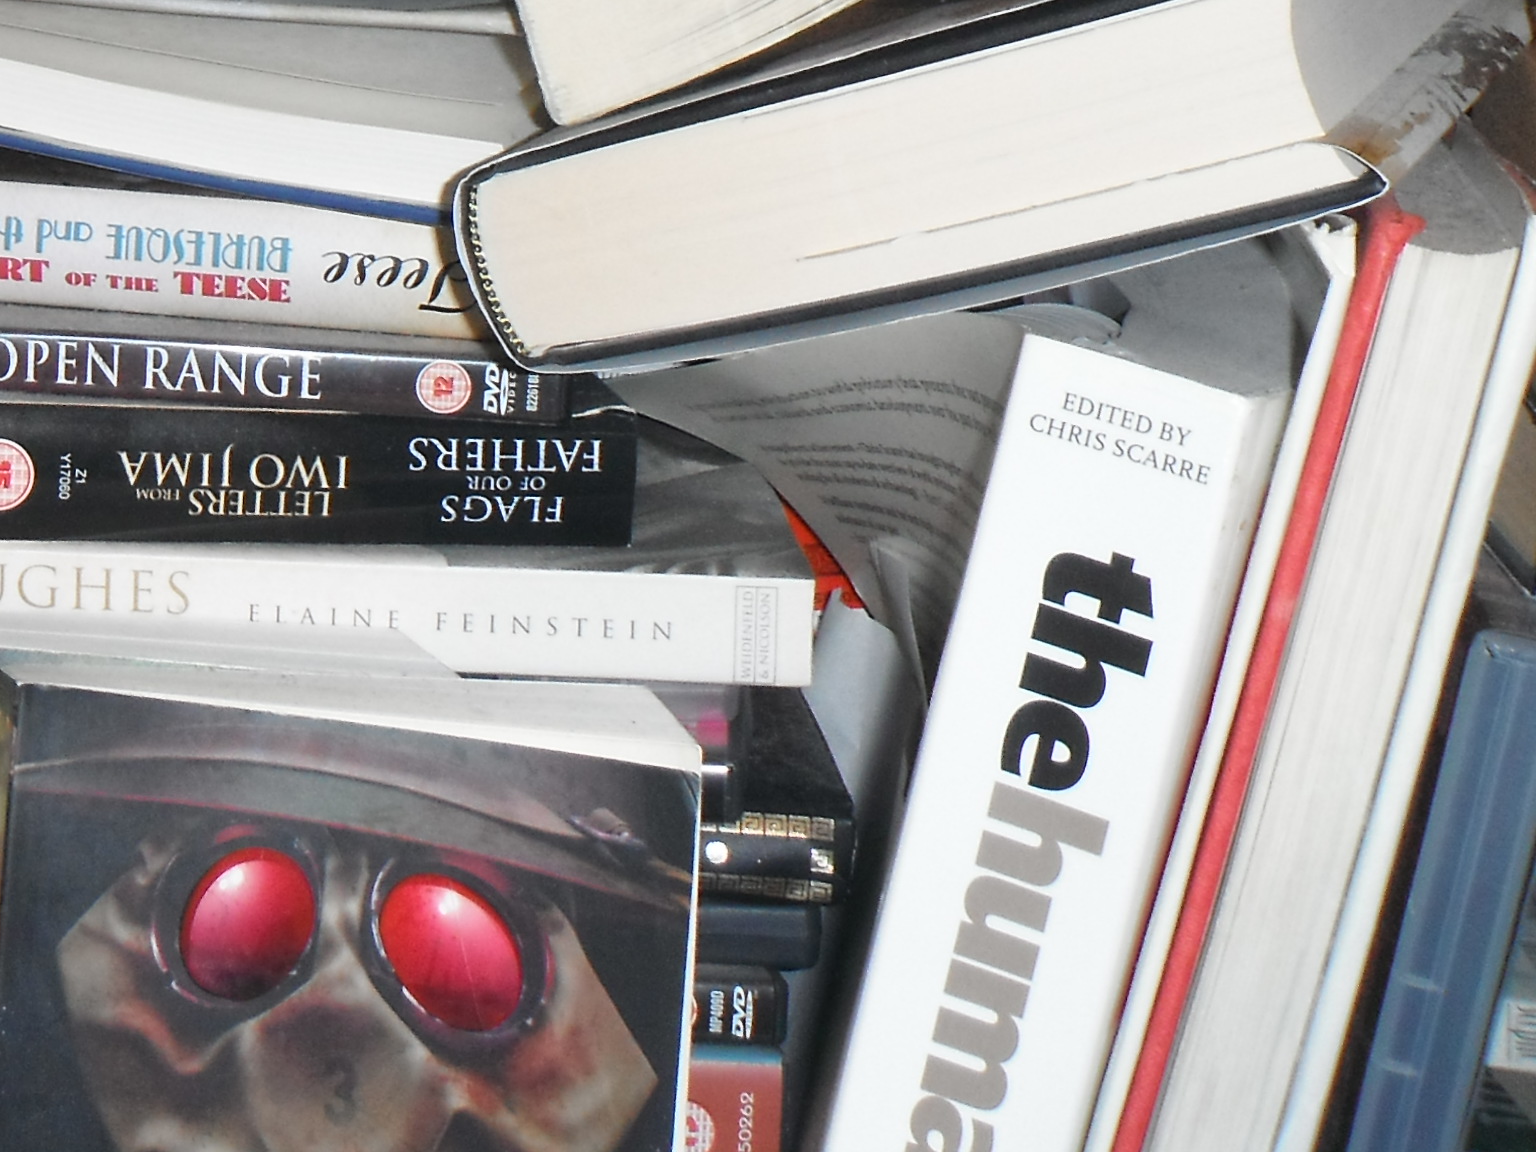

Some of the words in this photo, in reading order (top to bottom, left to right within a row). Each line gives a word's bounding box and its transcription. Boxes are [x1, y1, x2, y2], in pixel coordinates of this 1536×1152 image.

[36, 218, 93, 255] and
[107, 223, 293, 273] BURLESQUE
[65, 273, 98, 289] OF
[106, 275, 159, 294] THE
[174, 271, 292, 304] TEESE
[144, 347, 323, 400] RANGE
[433, 375, 455, 397] 12
[483, 362, 500, 414] DVD
[1062, 391, 1153, 437] EDITED
[1160, 421, 1191, 446] BY
[118, 445, 237, 489] JIMA
[409, 438, 602, 472] FATHERS
[1028, 415, 1108, 454] CHRIS
[1111, 437, 1211, 486] SCARRE
[58, 452, 72, 501] Y17060
[250, 454, 346, 489] IWO
[467, 476, 512, 490] OUR
[520, 477, 546, 490] OF
[136, 488, 180, 502] FROM
[188, 489, 329, 517] LETTERS
[440, 496, 564, 523] FLAGS
[249, 603, 402, 631] ELAINE
[435, 611, 674, 641] FEINSTEIN
[739, 588, 755, 681] WEIDENFELD
[760, 591, 772, 665] NICOLSON
[999, 550, 1154, 792] the
[732, 985, 745, 1038] DVD
